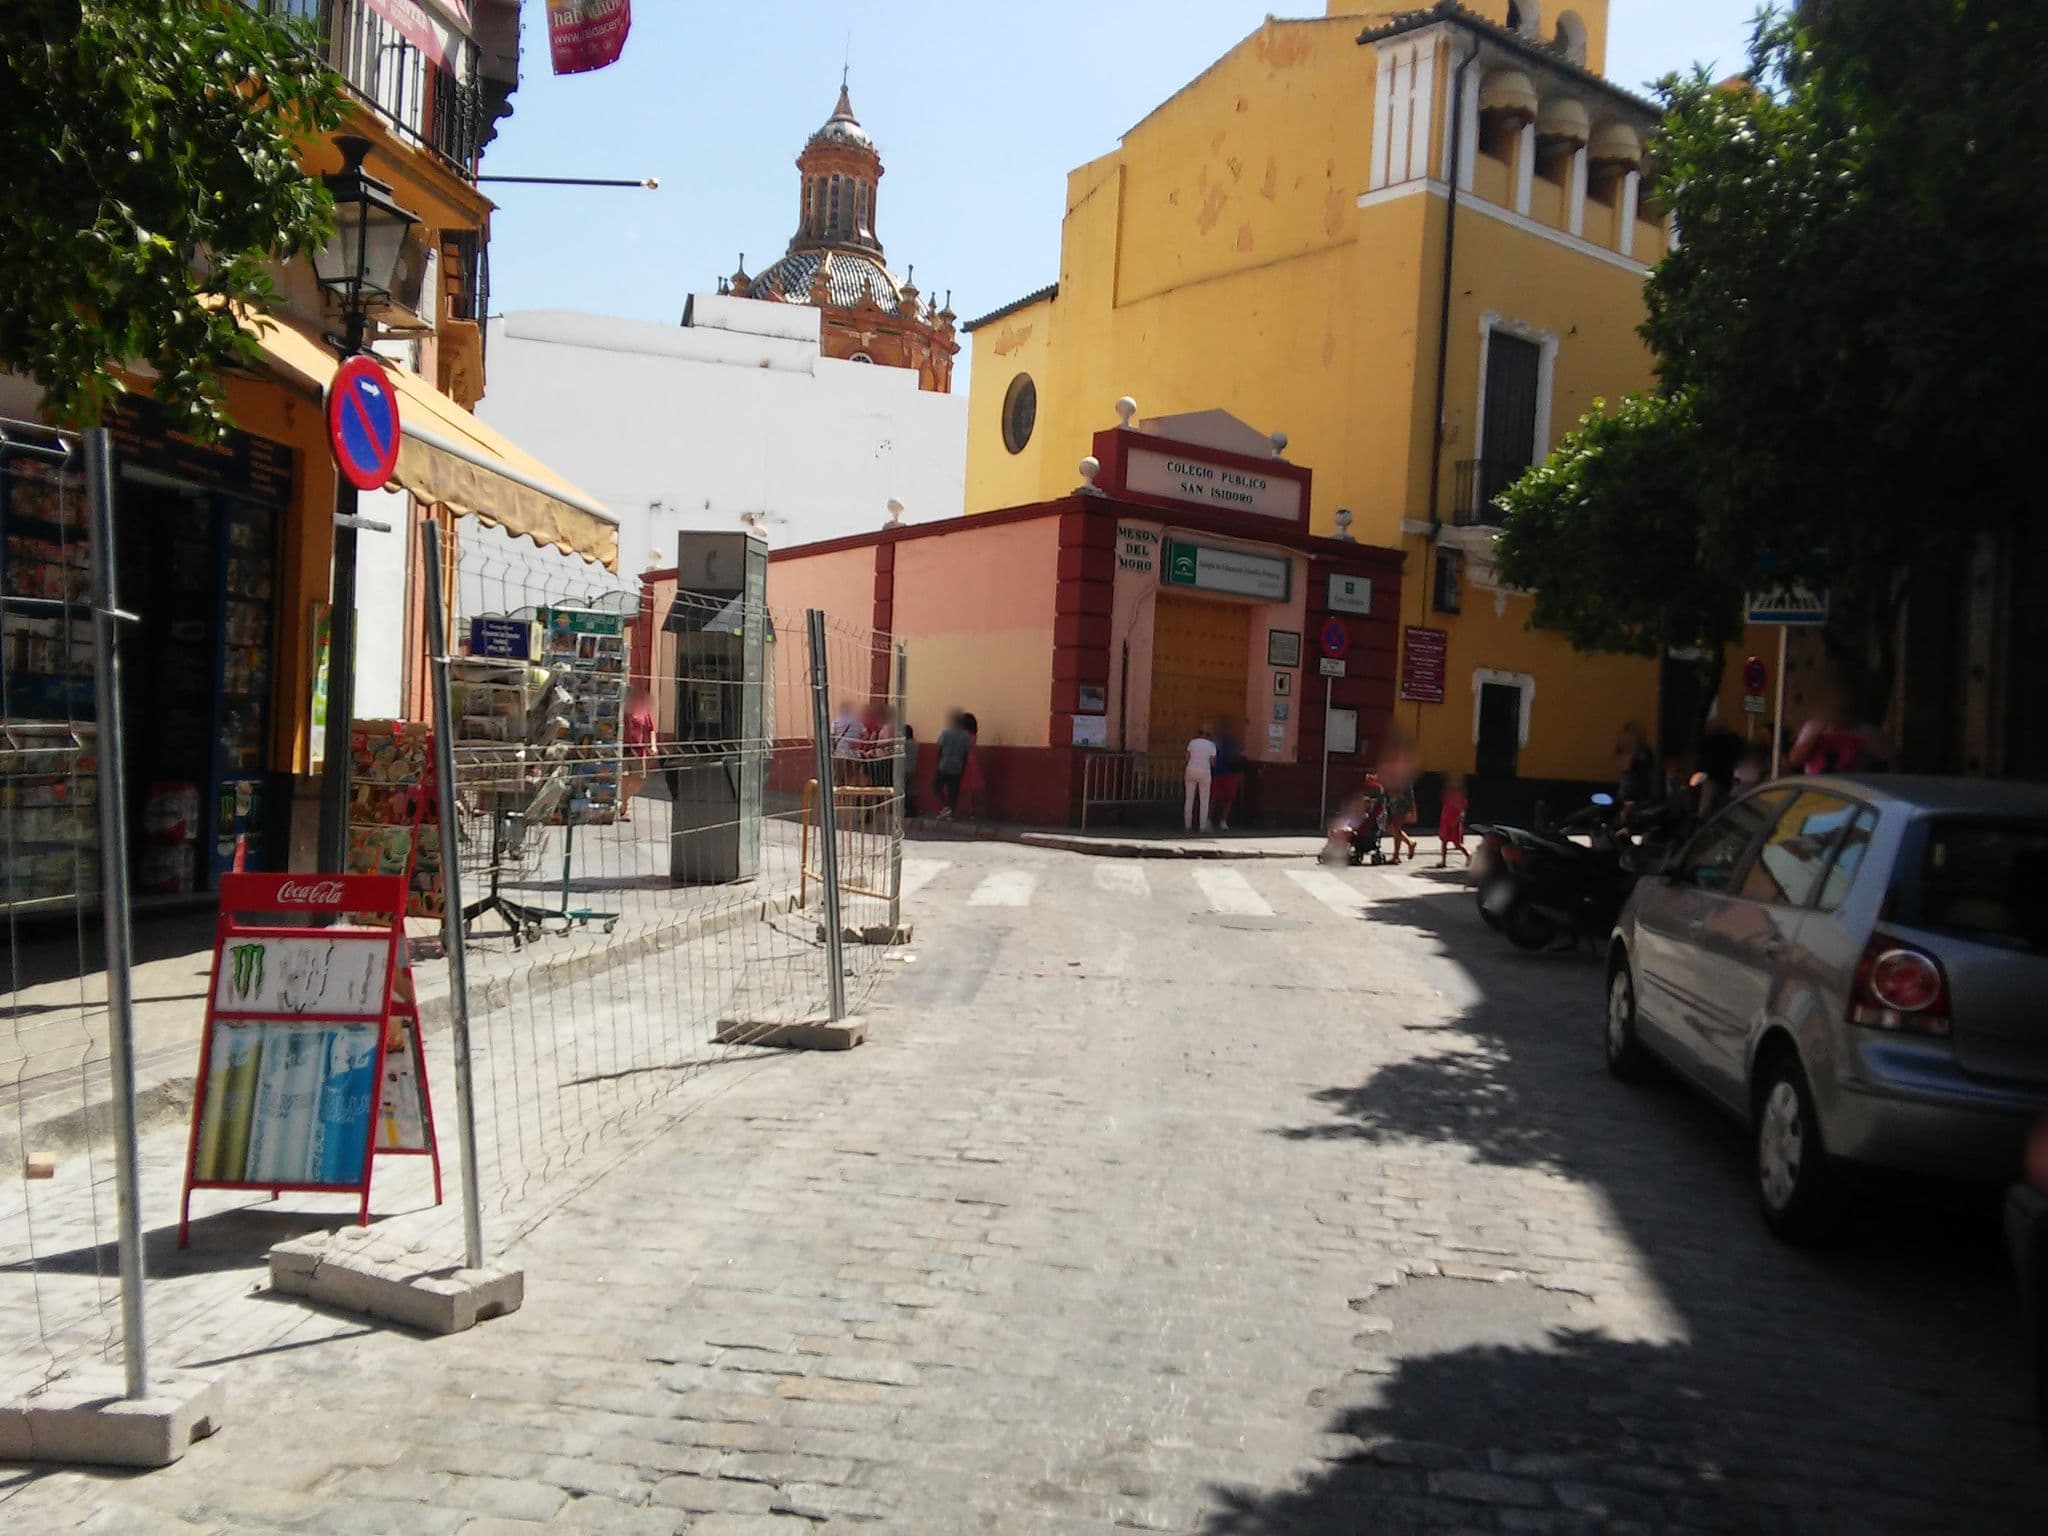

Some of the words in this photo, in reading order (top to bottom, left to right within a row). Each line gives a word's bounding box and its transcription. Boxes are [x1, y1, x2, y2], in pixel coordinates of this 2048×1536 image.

[1167, 460, 1214, 480] COLEGIO
[1221, 471, 1267, 490] PUBLICO
[1180, 480, 1204, 495] SAN
[1210, 486, 1254, 505] ISIDORO
[1118, 526, 1159, 544] MESON
[1125, 543, 1150, 557] DEL
[1118, 558, 1153, 572] MORO
